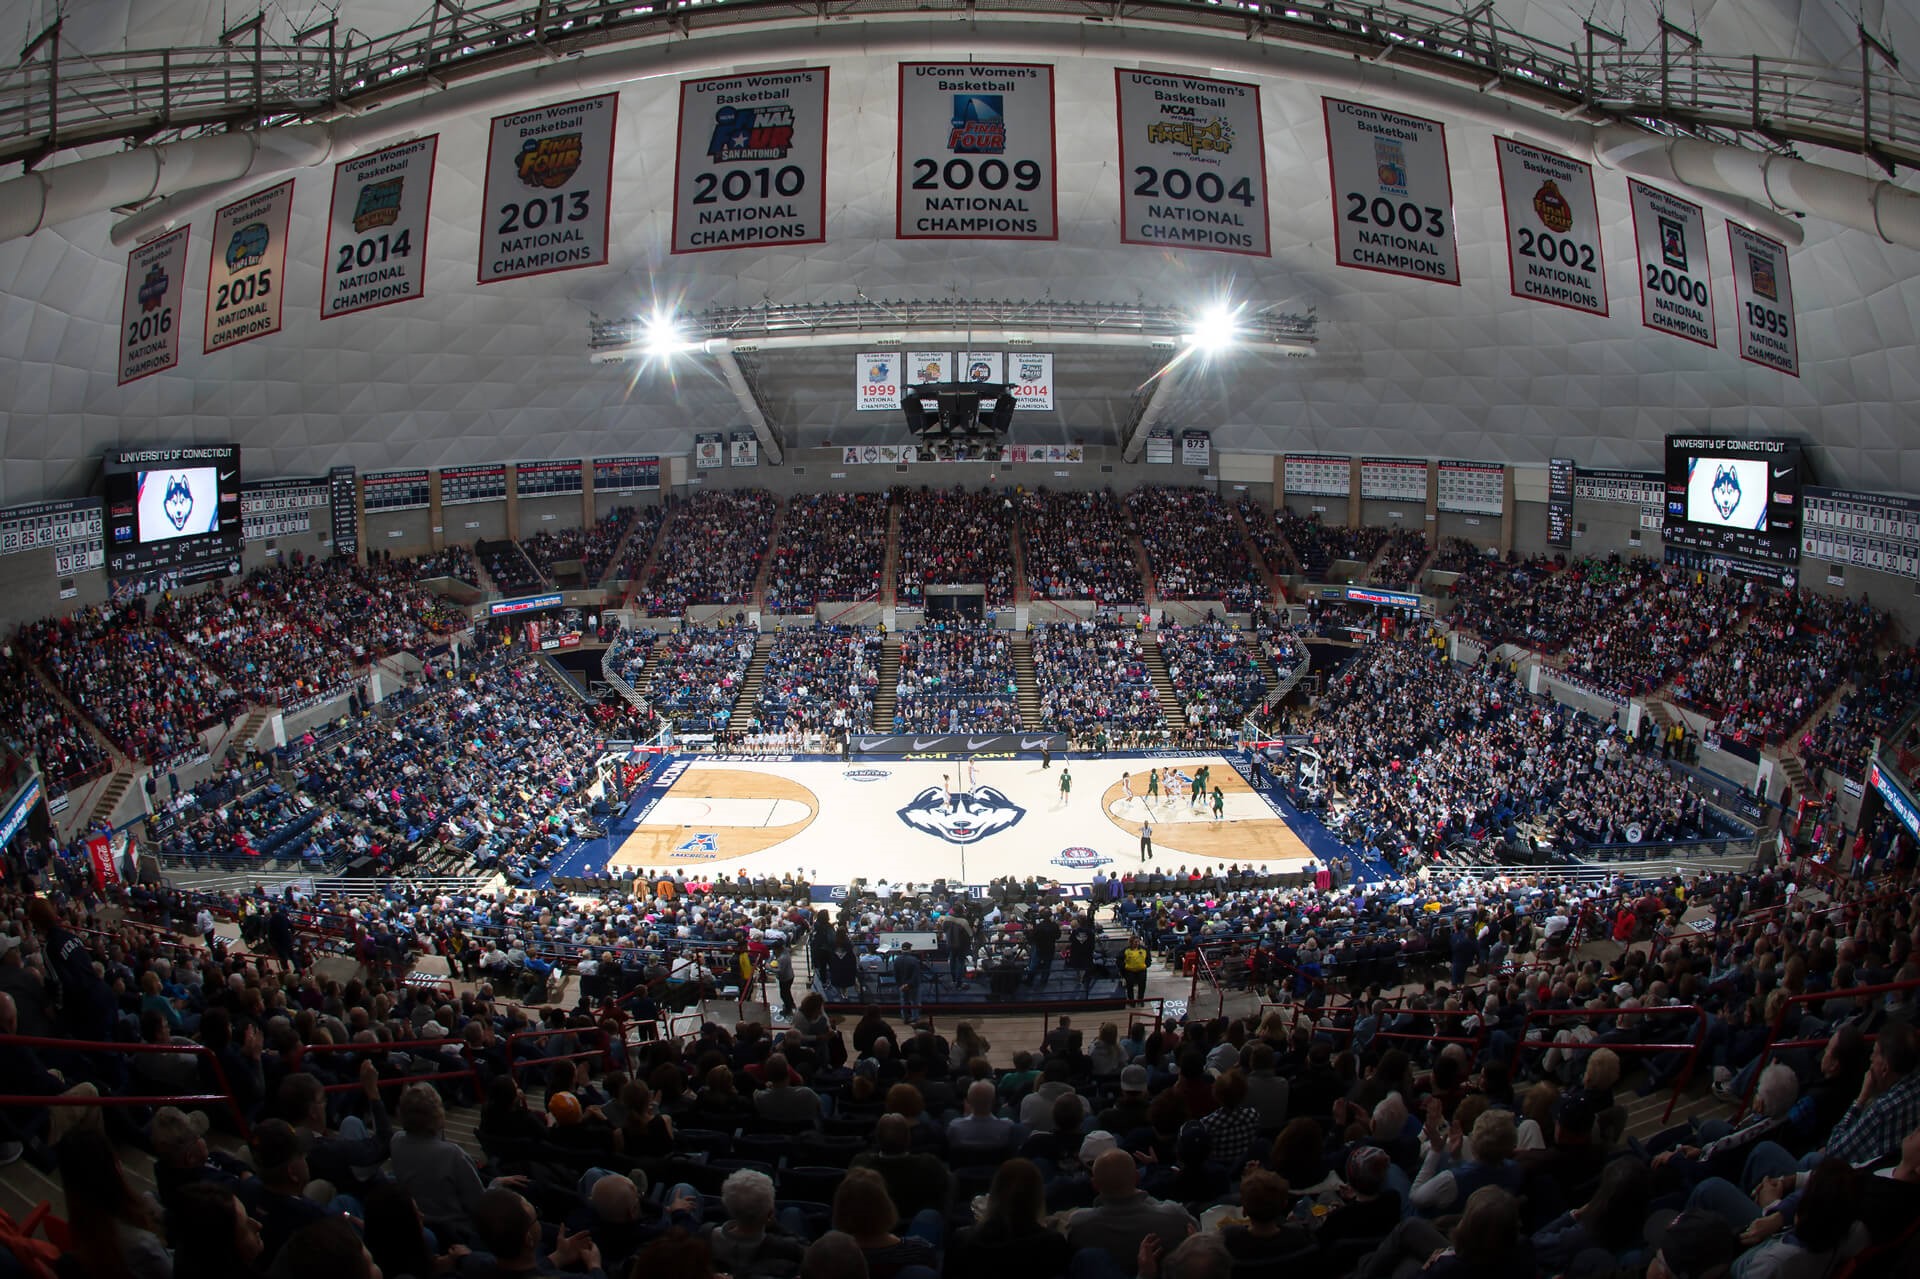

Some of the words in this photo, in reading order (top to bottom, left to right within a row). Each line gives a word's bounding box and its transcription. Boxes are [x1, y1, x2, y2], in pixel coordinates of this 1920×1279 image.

[697, 80, 742, 93] UConn
[747, 73, 812, 88] Women's
[916, 66, 964, 77] UConn
[970, 67, 1037, 78] Women's
[938, 81, 1015, 92] Basketball
[1132, 73, 1178, 88] UConn
[1182, 79, 1245, 97] Women's
[716, 88, 790, 105] Basketball
[1154, 90, 1226, 108] Basketball
[502, 113, 542, 128] UConn
[547, 100, 604, 118] Women's
[1160, 104, 1196, 116] NCAA
[1337, 104, 1378, 120] UConn
[1380, 112, 1433, 132] Women's
[519, 117, 583, 138] Basketball
[949, 128, 1004, 148] FOUR
[964, 121, 1004, 135] FINAL
[1357, 120, 1418, 142] Basketball
[537, 134, 581, 150] FINAL
[344, 156, 377, 173] UConn
[379, 141, 426, 163] Women's
[518, 149, 582, 178] FOUR
[1506, 144, 1540, 160] UConn
[1542, 152, 1584, 174] Women's
[357, 158, 409, 182] Basketball
[912, 158, 1041, 192] 2009
[1523, 160, 1572, 182] Basketball
[693, 165, 805, 205] 2010
[1134, 166, 1255, 208] 2004
[498, 190, 591, 235] 2013
[699, 204, 798, 225] NATIONAL
[926, 197, 1029, 212] NATIONAL
[1346, 192, 1445, 238] 2003
[917, 218, 1037, 233] CHAMPIONS
[1148, 205, 1244, 227] NATIONAL
[500, 228, 584, 254] NATIONAL
[690, 224, 806, 246] CHAMPIONS
[1141, 224, 1253, 248] CHAMPIONS
[1358, 230, 1438, 256] NATIONAL
[336, 229, 411, 274] 2014
[493, 246, 590, 274] CHAMPIONS
[1518, 227, 1597, 273] 2002
[1352, 248, 1446, 276] CHAMPIONS
[339, 265, 406, 292] NATIONAL
[1528, 263, 1592, 290] NATIONAL
[1646, 263, 1708, 308] 2000
[216, 268, 272, 312] 2015
[332, 282, 410, 310] CHAMPIONS
[1524, 280, 1598, 308] CHAMPIONS
[217, 302, 268, 328] NATIONAL
[1656, 296, 1704, 323] NATIONAL
[1744, 300, 1789, 339] 1995
[127, 307, 172, 348] 2016
[212, 318, 272, 345] CHAMPIONS
[1652, 312, 1709, 340] CHAMPIONS
[128, 339, 168, 362] NATIONAL
[1750, 330, 1789, 354] NATIONAL
[124, 352, 170, 378] CHAMPIONS
[1747, 345, 1793, 370] CHAMPIONS
[862, 384, 896, 396] 1999
[1014, 386, 1048, 396] 2014
[1187, 440, 1206, 448] 873
[1673, 439, 1714, 450] UNIVERSITY
[1716, 440, 1726, 450] OF
[1727, 440, 1785, 452] CONNECTICUT
[120, 451, 170, 463] UNIVERSITY
[171, 450, 182, 460] OF
[182, 448, 232, 459] CONNECTICUT
[1576, 486, 1584, 495] 24
[1608, 489, 1616, 498] 52
[242, 502, 250, 512] 52
[1668, 502, 1682, 510] CBS
[40, 528, 52, 540] 42
[56, 525, 68, 538] 44
[88, 520, 100, 532] 42
[114, 526, 131, 536] CBS
[4, 534, 17, 548] 22
[22, 531, 34, 544] 25
[59, 558, 70, 570] 13
[75, 554, 86, 567] 22
[1872, 552, 1878, 564] 4
[1886, 555, 1897, 568] 30
[694, 754, 794, 762] HUSKIES
[902, 752, 949, 760] Advil
[970, 752, 1018, 760] Advil
